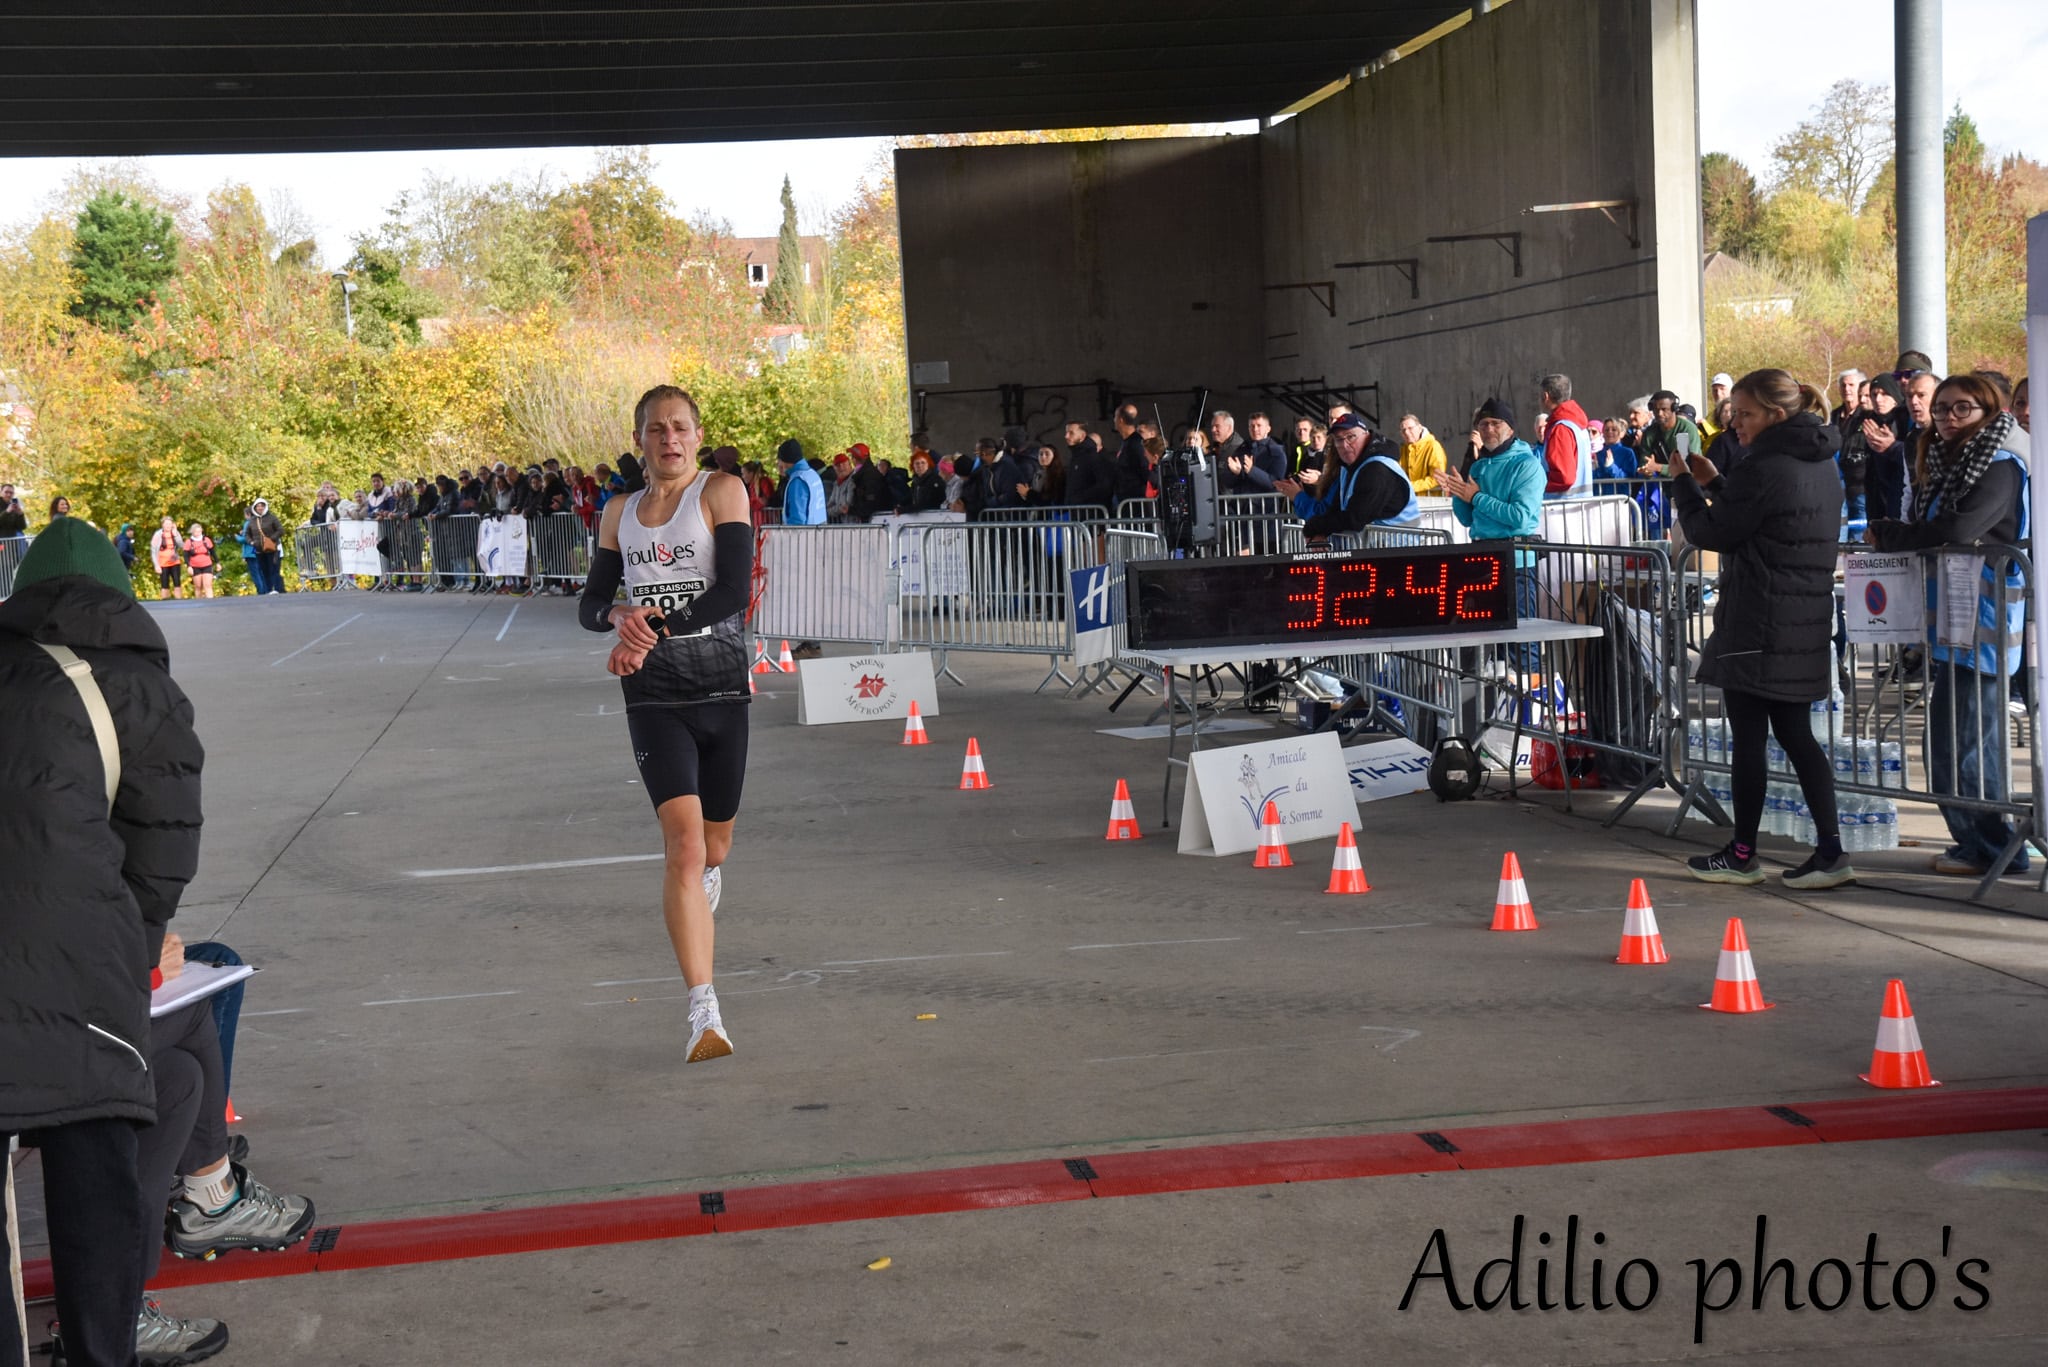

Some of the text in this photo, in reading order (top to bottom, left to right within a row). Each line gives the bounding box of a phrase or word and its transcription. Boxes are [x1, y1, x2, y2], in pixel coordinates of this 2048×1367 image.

[1293, 551, 1352, 561] MATSPORT TIMING
[634, 582, 701, 596] LES 4 SAISONS
[849, 659, 885, 671] AMIENS
[1268, 747, 1307, 769] Amicale
[1295, 776, 1308, 792] du
[1289, 808, 1323, 825] Somme
